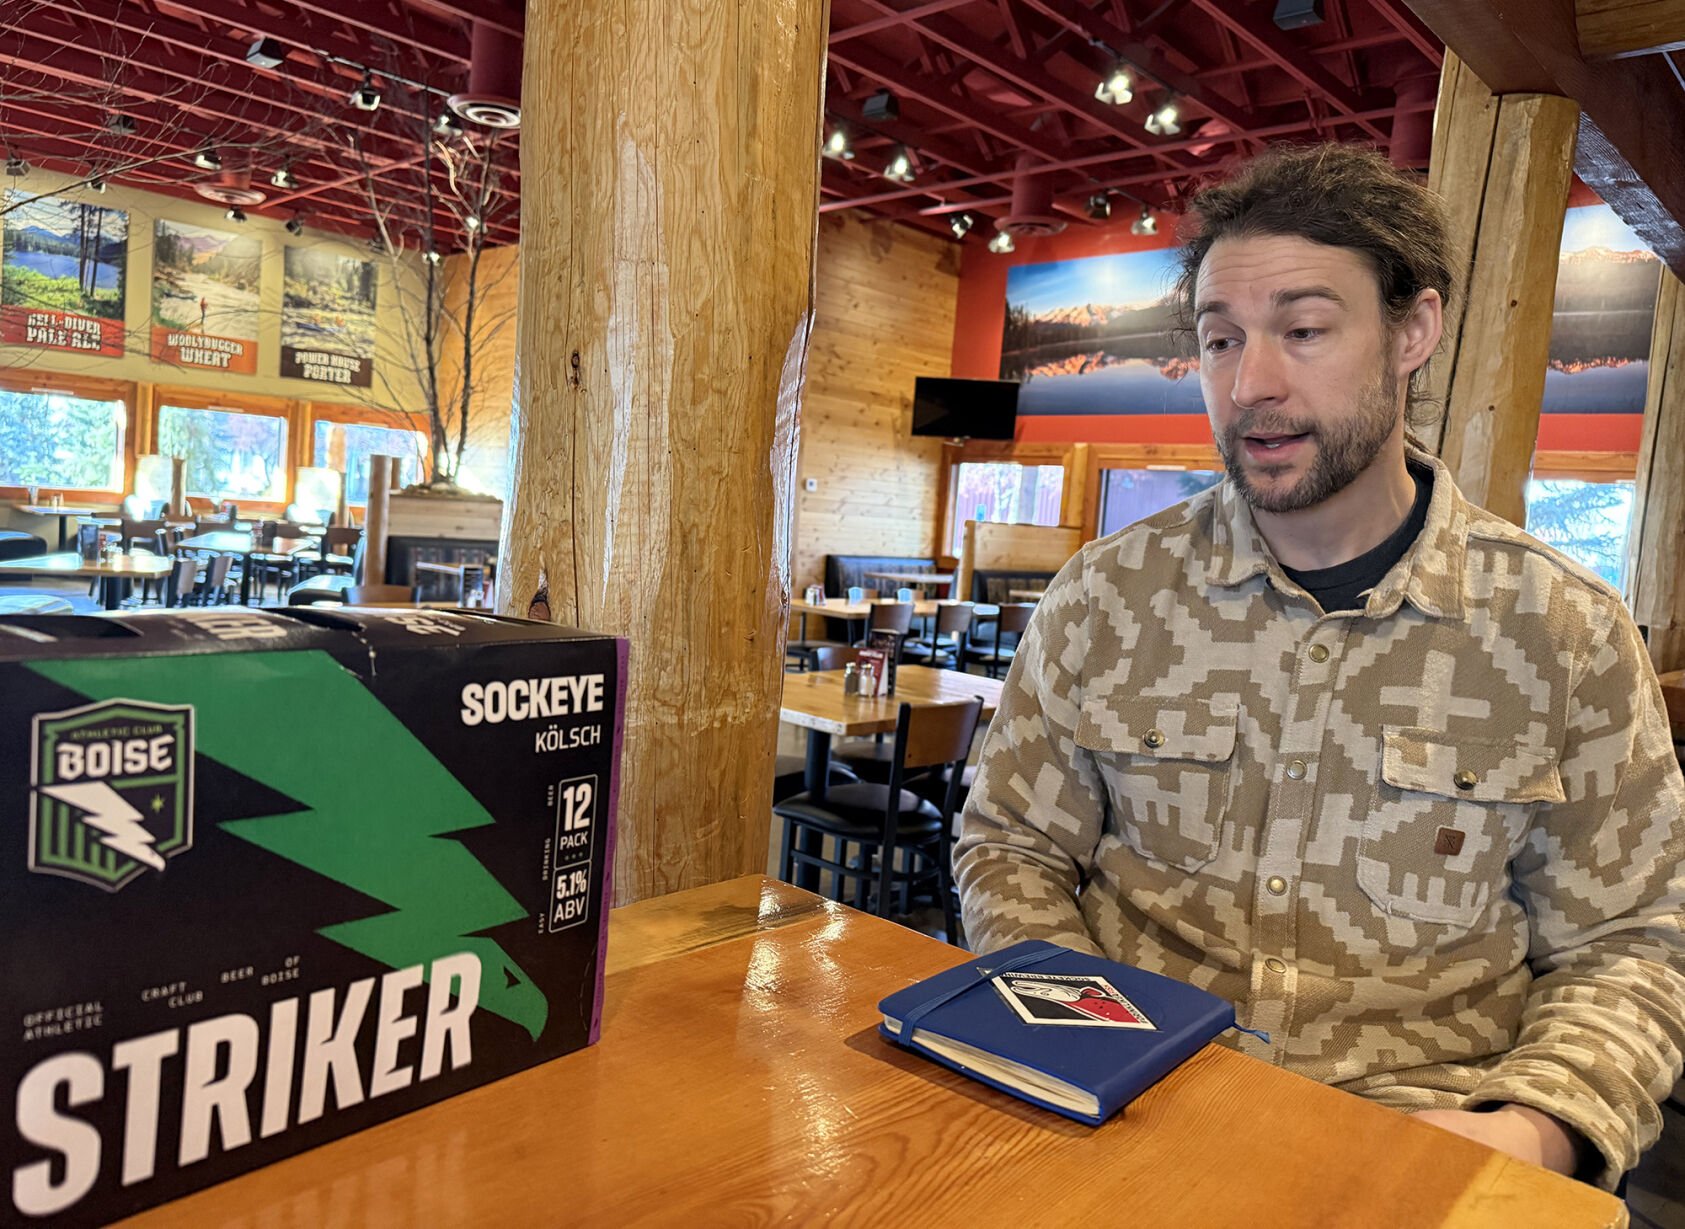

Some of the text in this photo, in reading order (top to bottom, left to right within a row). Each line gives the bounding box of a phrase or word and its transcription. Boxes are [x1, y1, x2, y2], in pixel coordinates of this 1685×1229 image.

[26, 327, 67, 347] PALE
[180, 346, 232, 368] WHEAT
[303, 363, 351, 384] PORTER
[461, 673, 604, 726] SOCKEYE
[69, 723, 163, 740] ATHLETIC CLUB
[534, 724, 601, 753] KÖLSCH
[56, 734, 175, 781] BOISE
[562, 782, 593, 832] 12
[559, 831, 589, 850] PACK
[537, 912, 545, 935] EASY
[546, 785, 555, 807] BEER
[556, 868, 588, 900] 5.1%
[553, 896, 586, 924] ABV
[23, 955, 300, 1028] OFFICIAL CRAFT BEER OF
[23, 967, 300, 1041] ATHLETIC CLUB BOISE
[12, 951, 482, 1218] STRIKER
